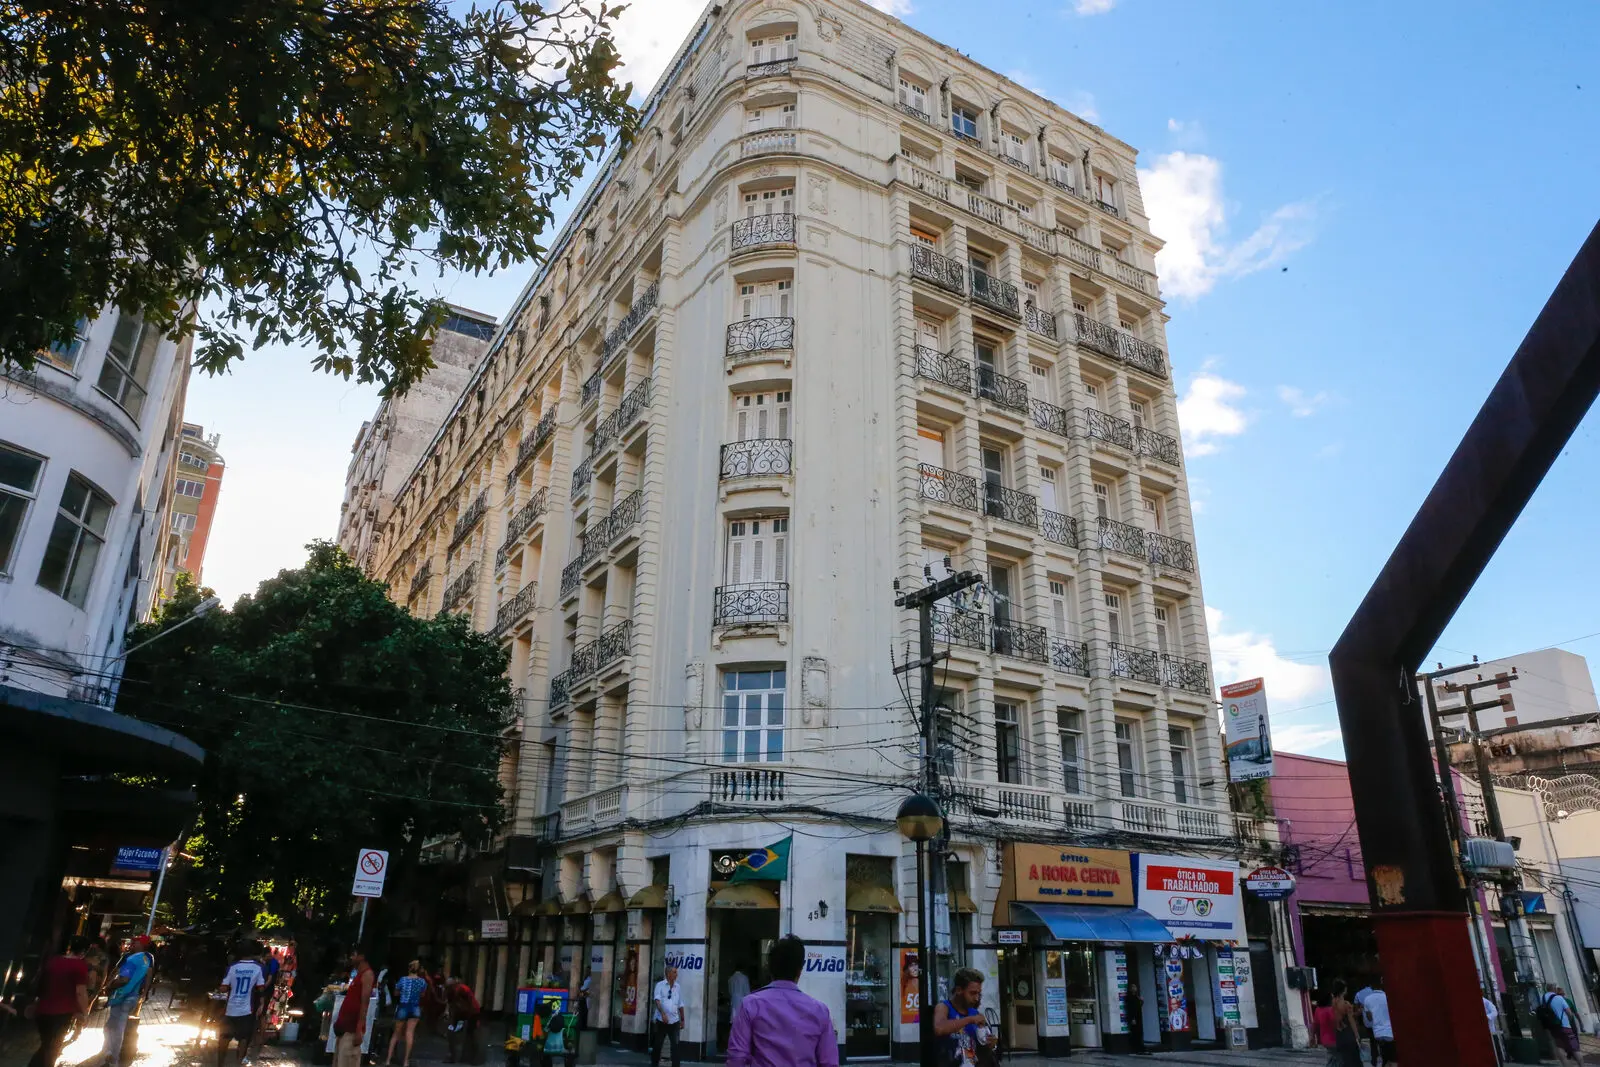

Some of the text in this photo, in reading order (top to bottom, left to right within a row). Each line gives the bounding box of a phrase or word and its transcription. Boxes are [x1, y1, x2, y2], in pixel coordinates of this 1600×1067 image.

[134, 848, 159, 859] Facundo
[1061, 853, 1089, 863] ÓPTICA
[1029, 864, 1121, 885] A HORA CERTA
[1177, 869, 1207, 882] ÓTICA DO
[1162, 878, 1220, 894] TRABALHADOR
[807, 910, 819, 921] 45
[806, 955, 845, 973] Visão
[235, 976, 251, 995] 10
